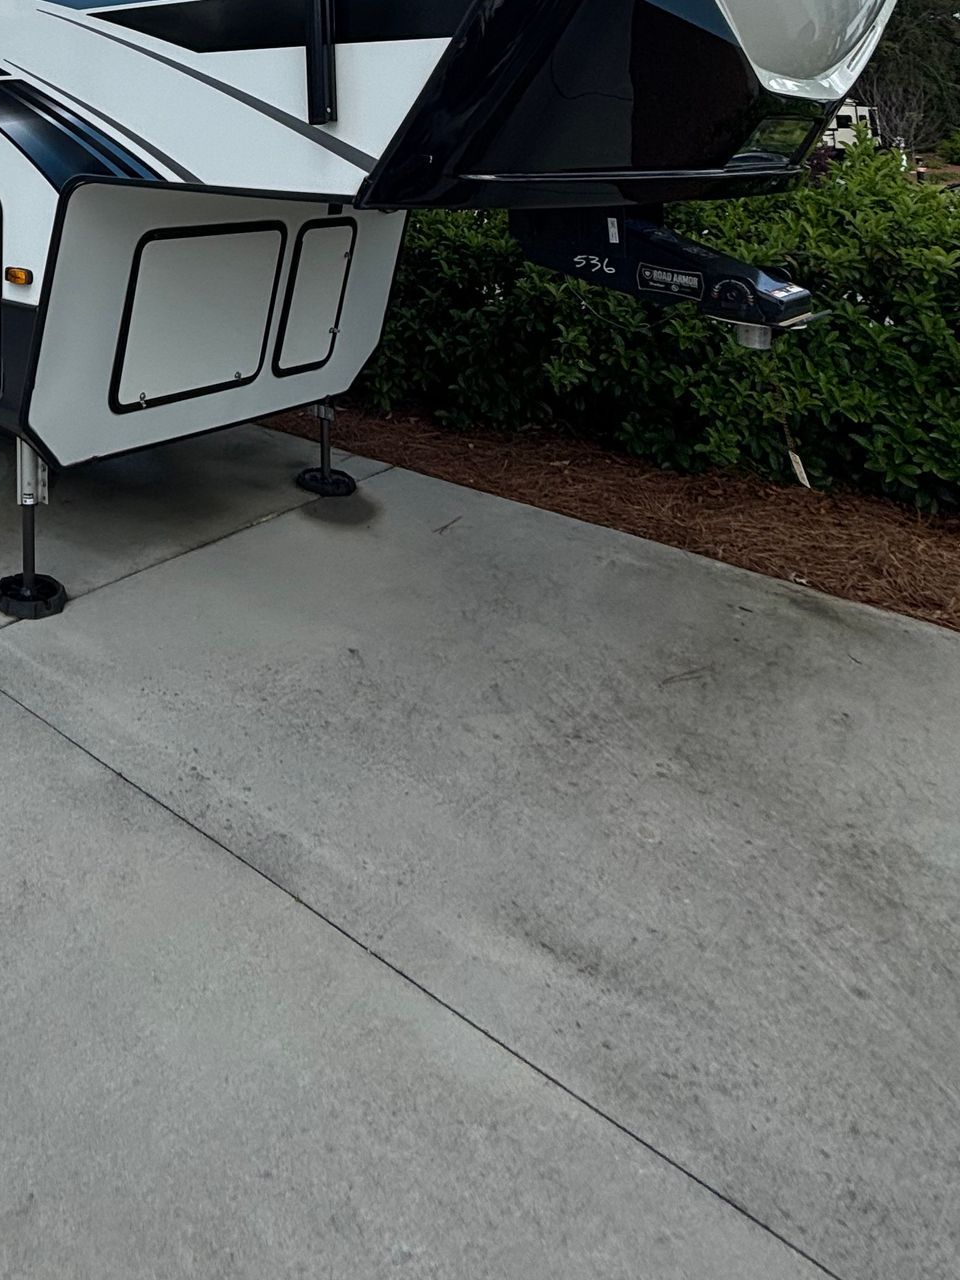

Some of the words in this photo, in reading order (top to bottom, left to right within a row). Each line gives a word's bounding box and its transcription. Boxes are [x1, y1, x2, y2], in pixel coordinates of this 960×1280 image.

[573, 255, 616, 274] 536
[652, 270, 672, 282] ROAD
[673, 273, 699, 288] ARMOR
